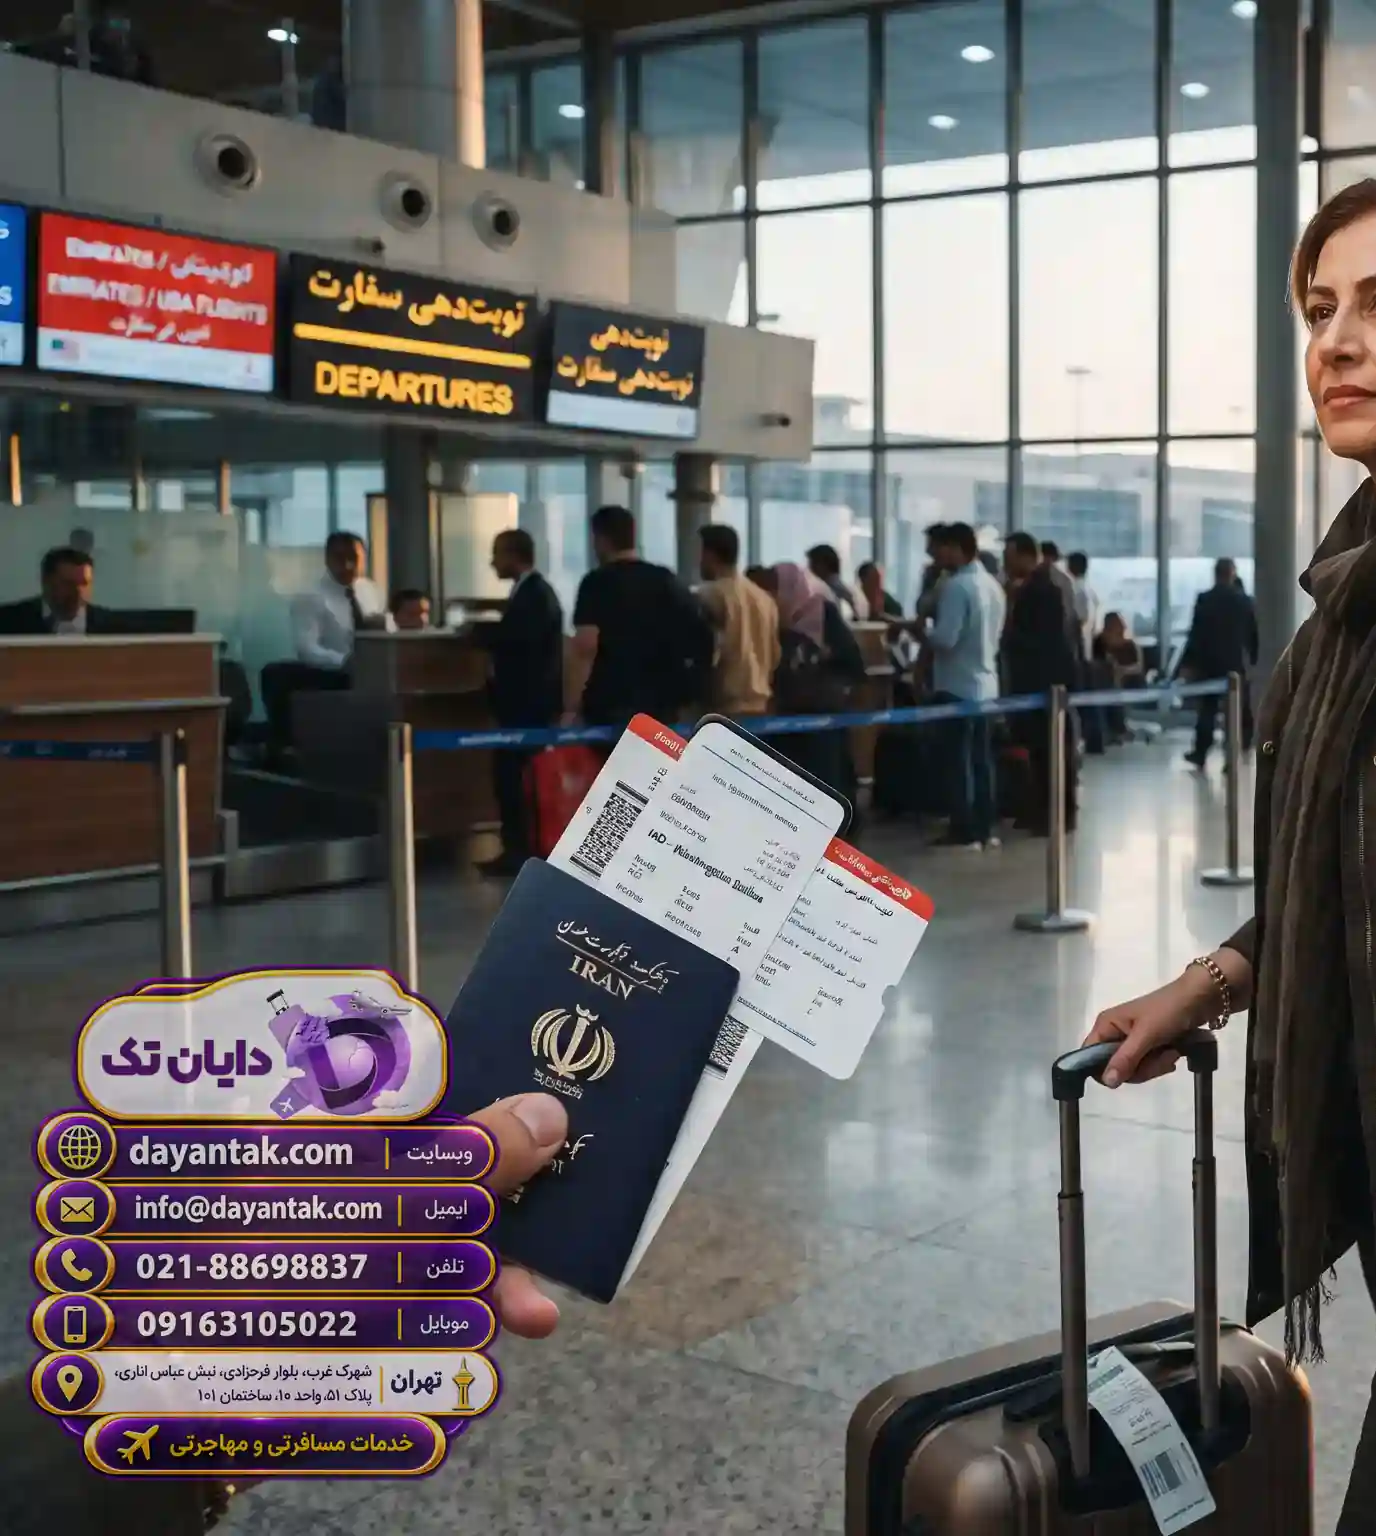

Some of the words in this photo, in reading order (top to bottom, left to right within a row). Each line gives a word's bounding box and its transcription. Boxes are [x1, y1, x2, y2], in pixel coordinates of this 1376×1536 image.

[308, 270, 402, 312] سفارت
[315, 361, 513, 415] DEPARTURES
[568, 954, 636, 1000] IRAN
